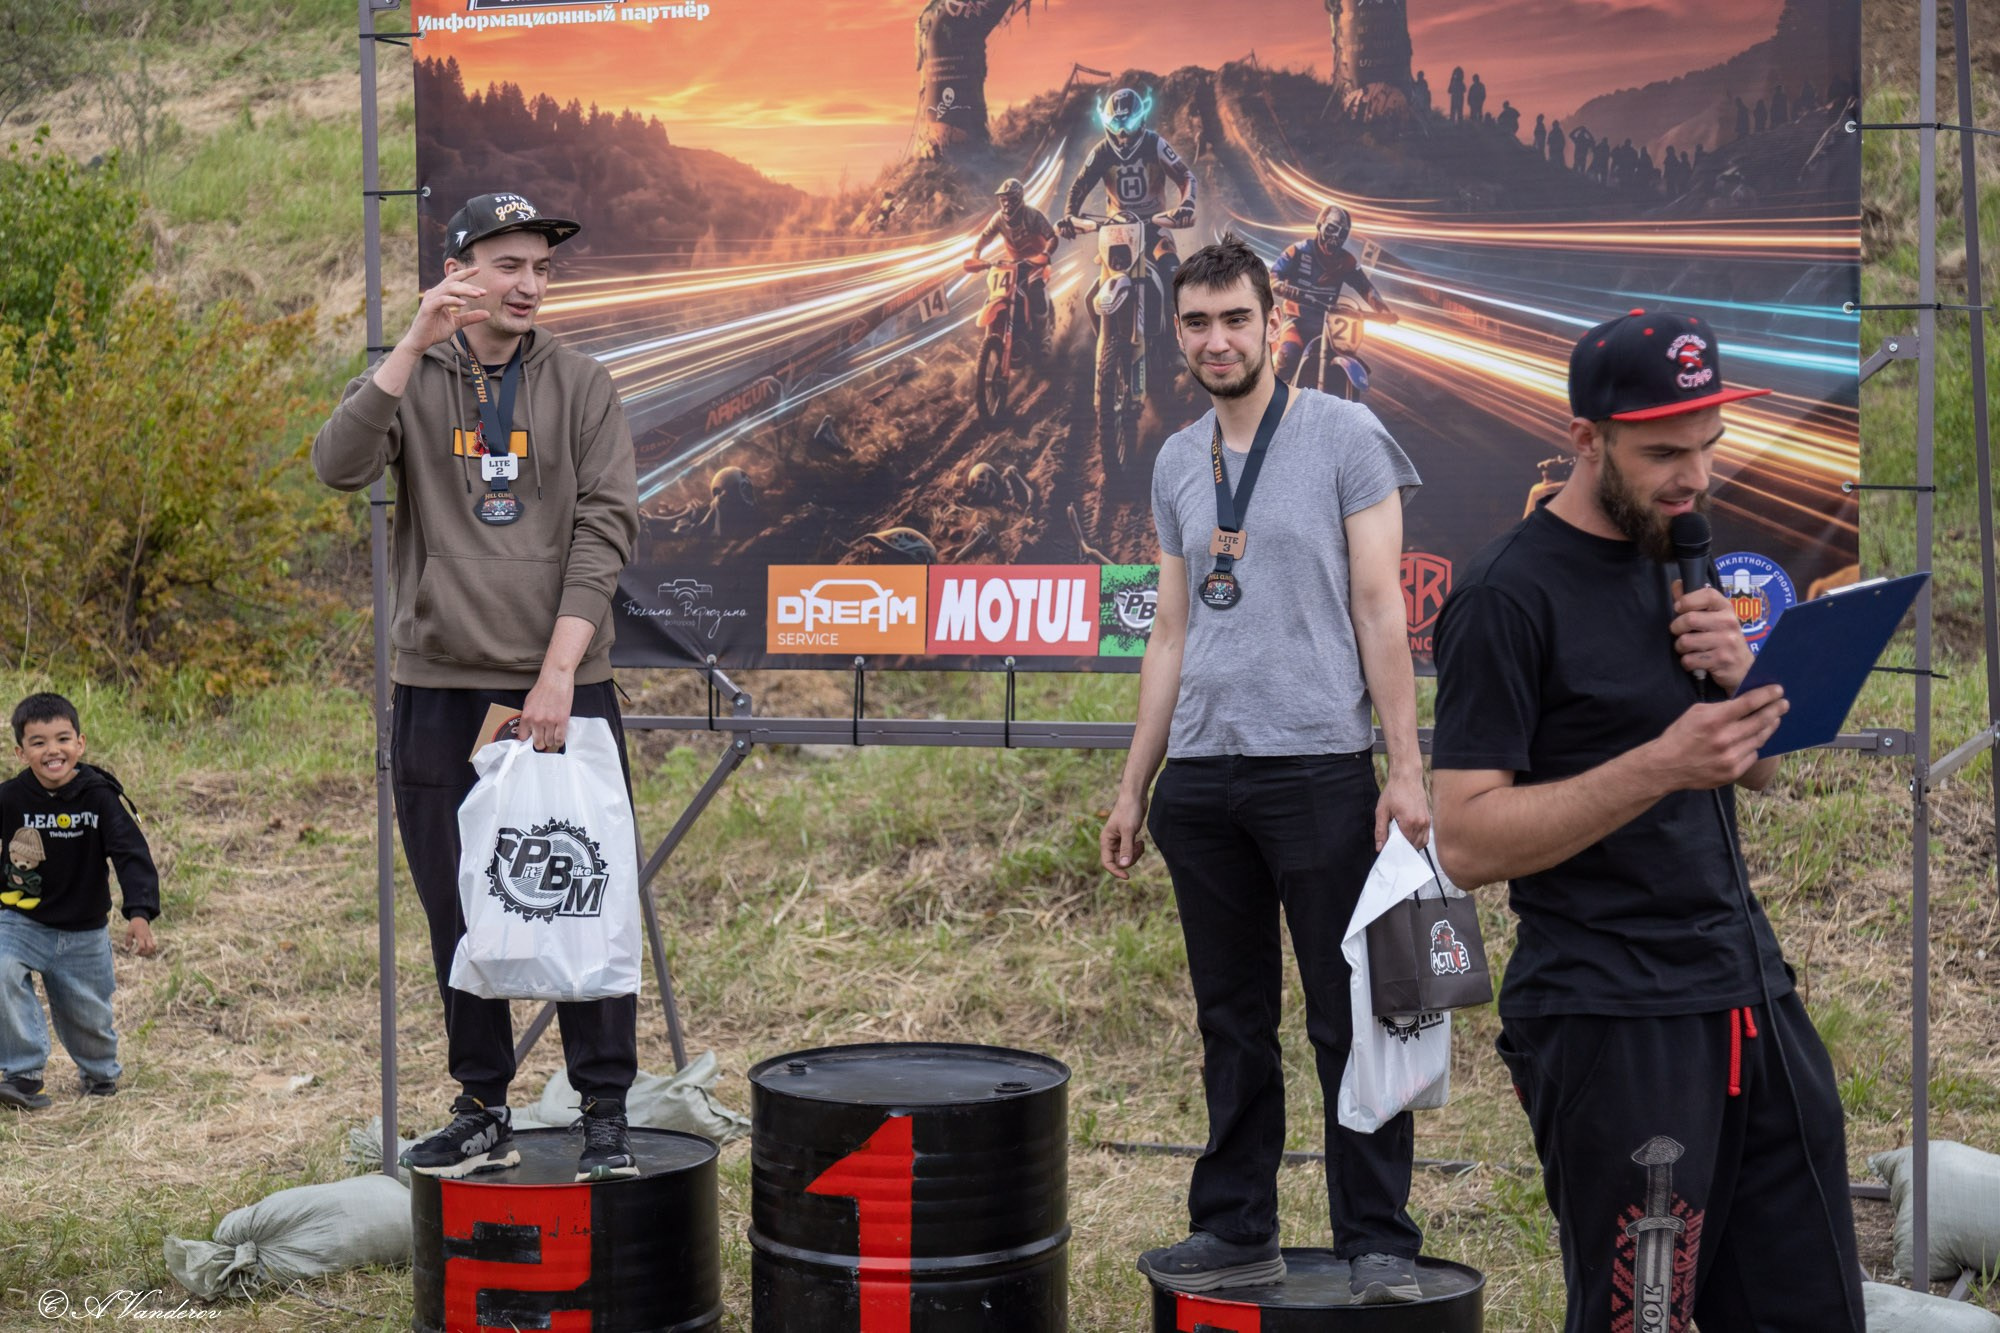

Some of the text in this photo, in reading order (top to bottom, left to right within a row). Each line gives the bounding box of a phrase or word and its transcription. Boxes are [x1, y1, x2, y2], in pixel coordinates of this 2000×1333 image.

[418, 1, 711, 33] Информационный партнёр
[993, 272, 1011, 293] 14
[921, 288, 944, 318] 14
[1332, 317, 1358, 345] 21
[474, 376, 489, 403] HILL
[489, 460, 511, 468] LITE
[495, 467, 504, 476] 2
[1218, 535, 1239, 545] LITE
[1223, 543, 1231, 553] 3
[1716, 556, 1793, 605] ИКЛЕТНОГО СПОРТА
[777, 590, 916, 632] DREAM
[935, 578, 1091, 643] MOTUL
[777, 632, 839, 646] SERVICE
[1432, 945, 1467, 969] ACTIVE
[461, 1122, 499, 1158] 3M
[806, 1115, 914, 1333] 1
[440, 1179, 592, 1333] 2
